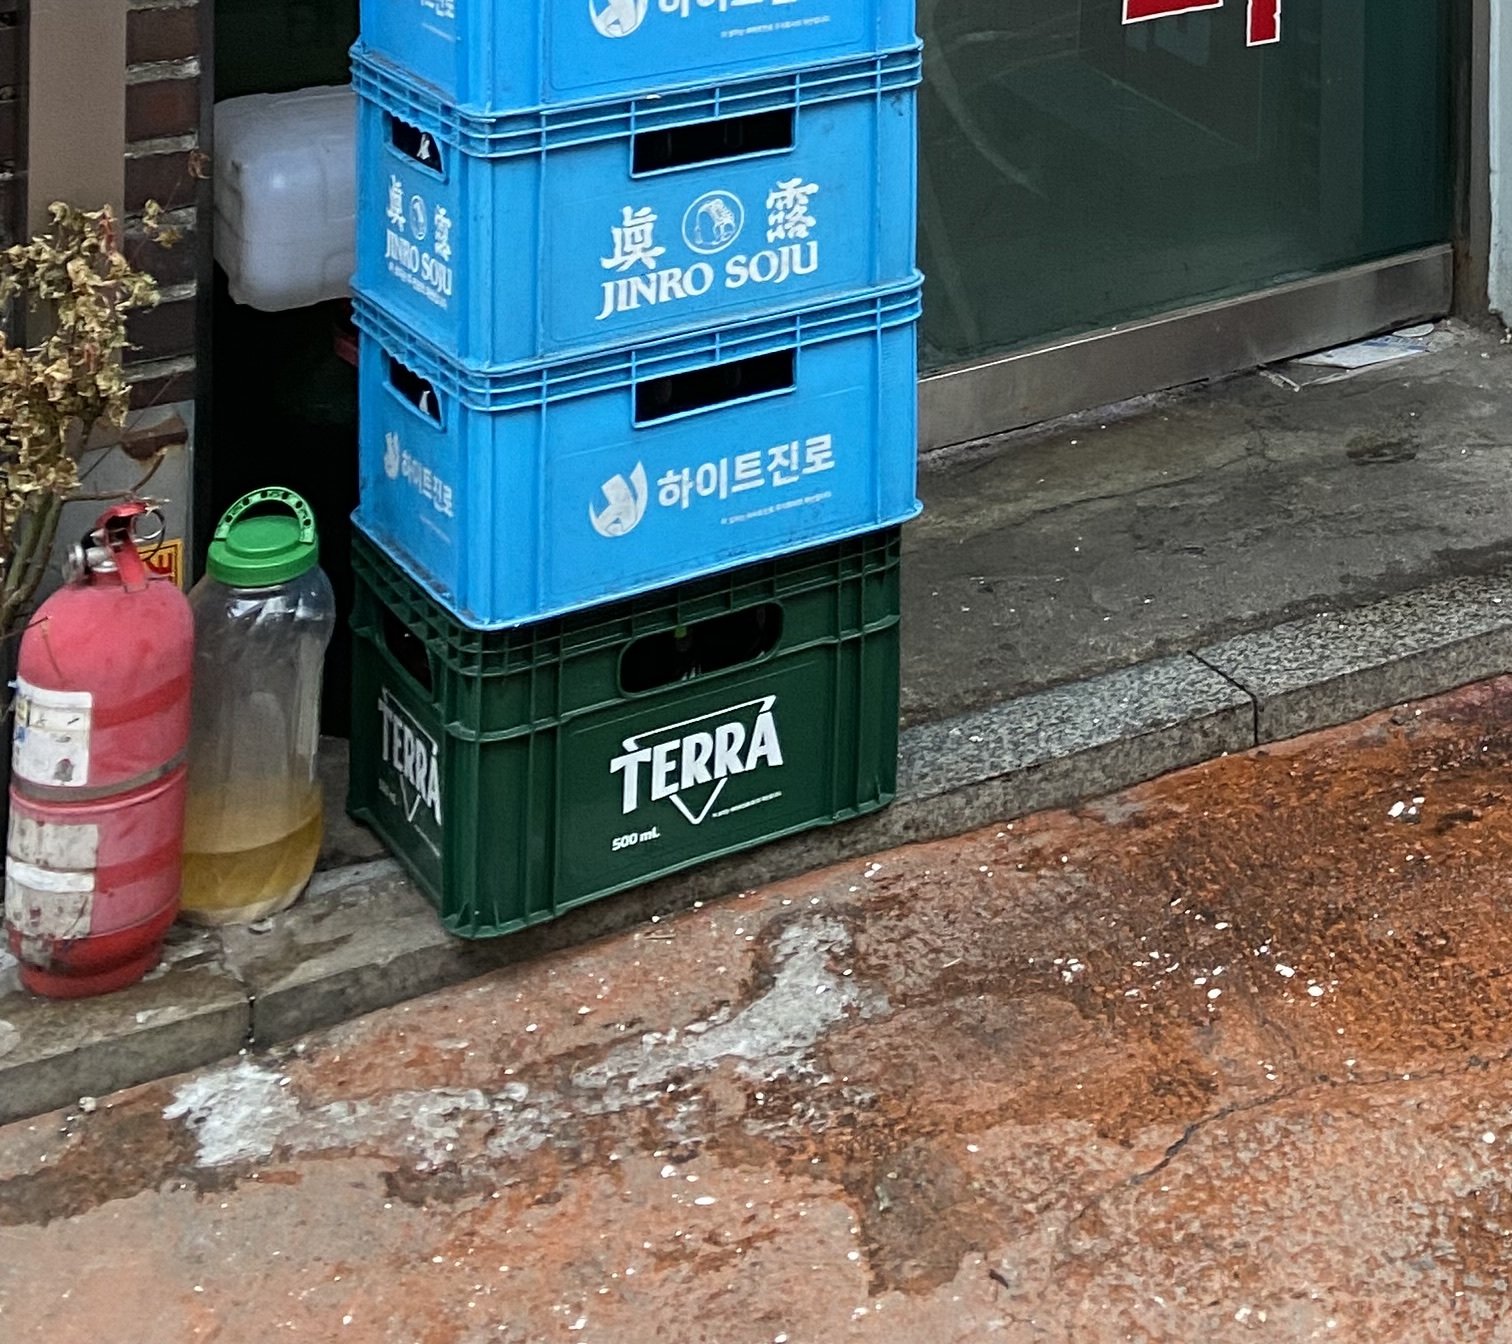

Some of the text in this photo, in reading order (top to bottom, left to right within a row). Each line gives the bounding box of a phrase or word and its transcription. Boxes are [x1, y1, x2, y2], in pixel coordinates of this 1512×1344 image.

[595, 241, 819, 321] JINRO SOJU
[656, 433, 836, 510] 하이트진로
[377, 697, 443, 826] TERRA
[609, 711, 784, 814] TERRA
[612, 832, 639, 852] 500
